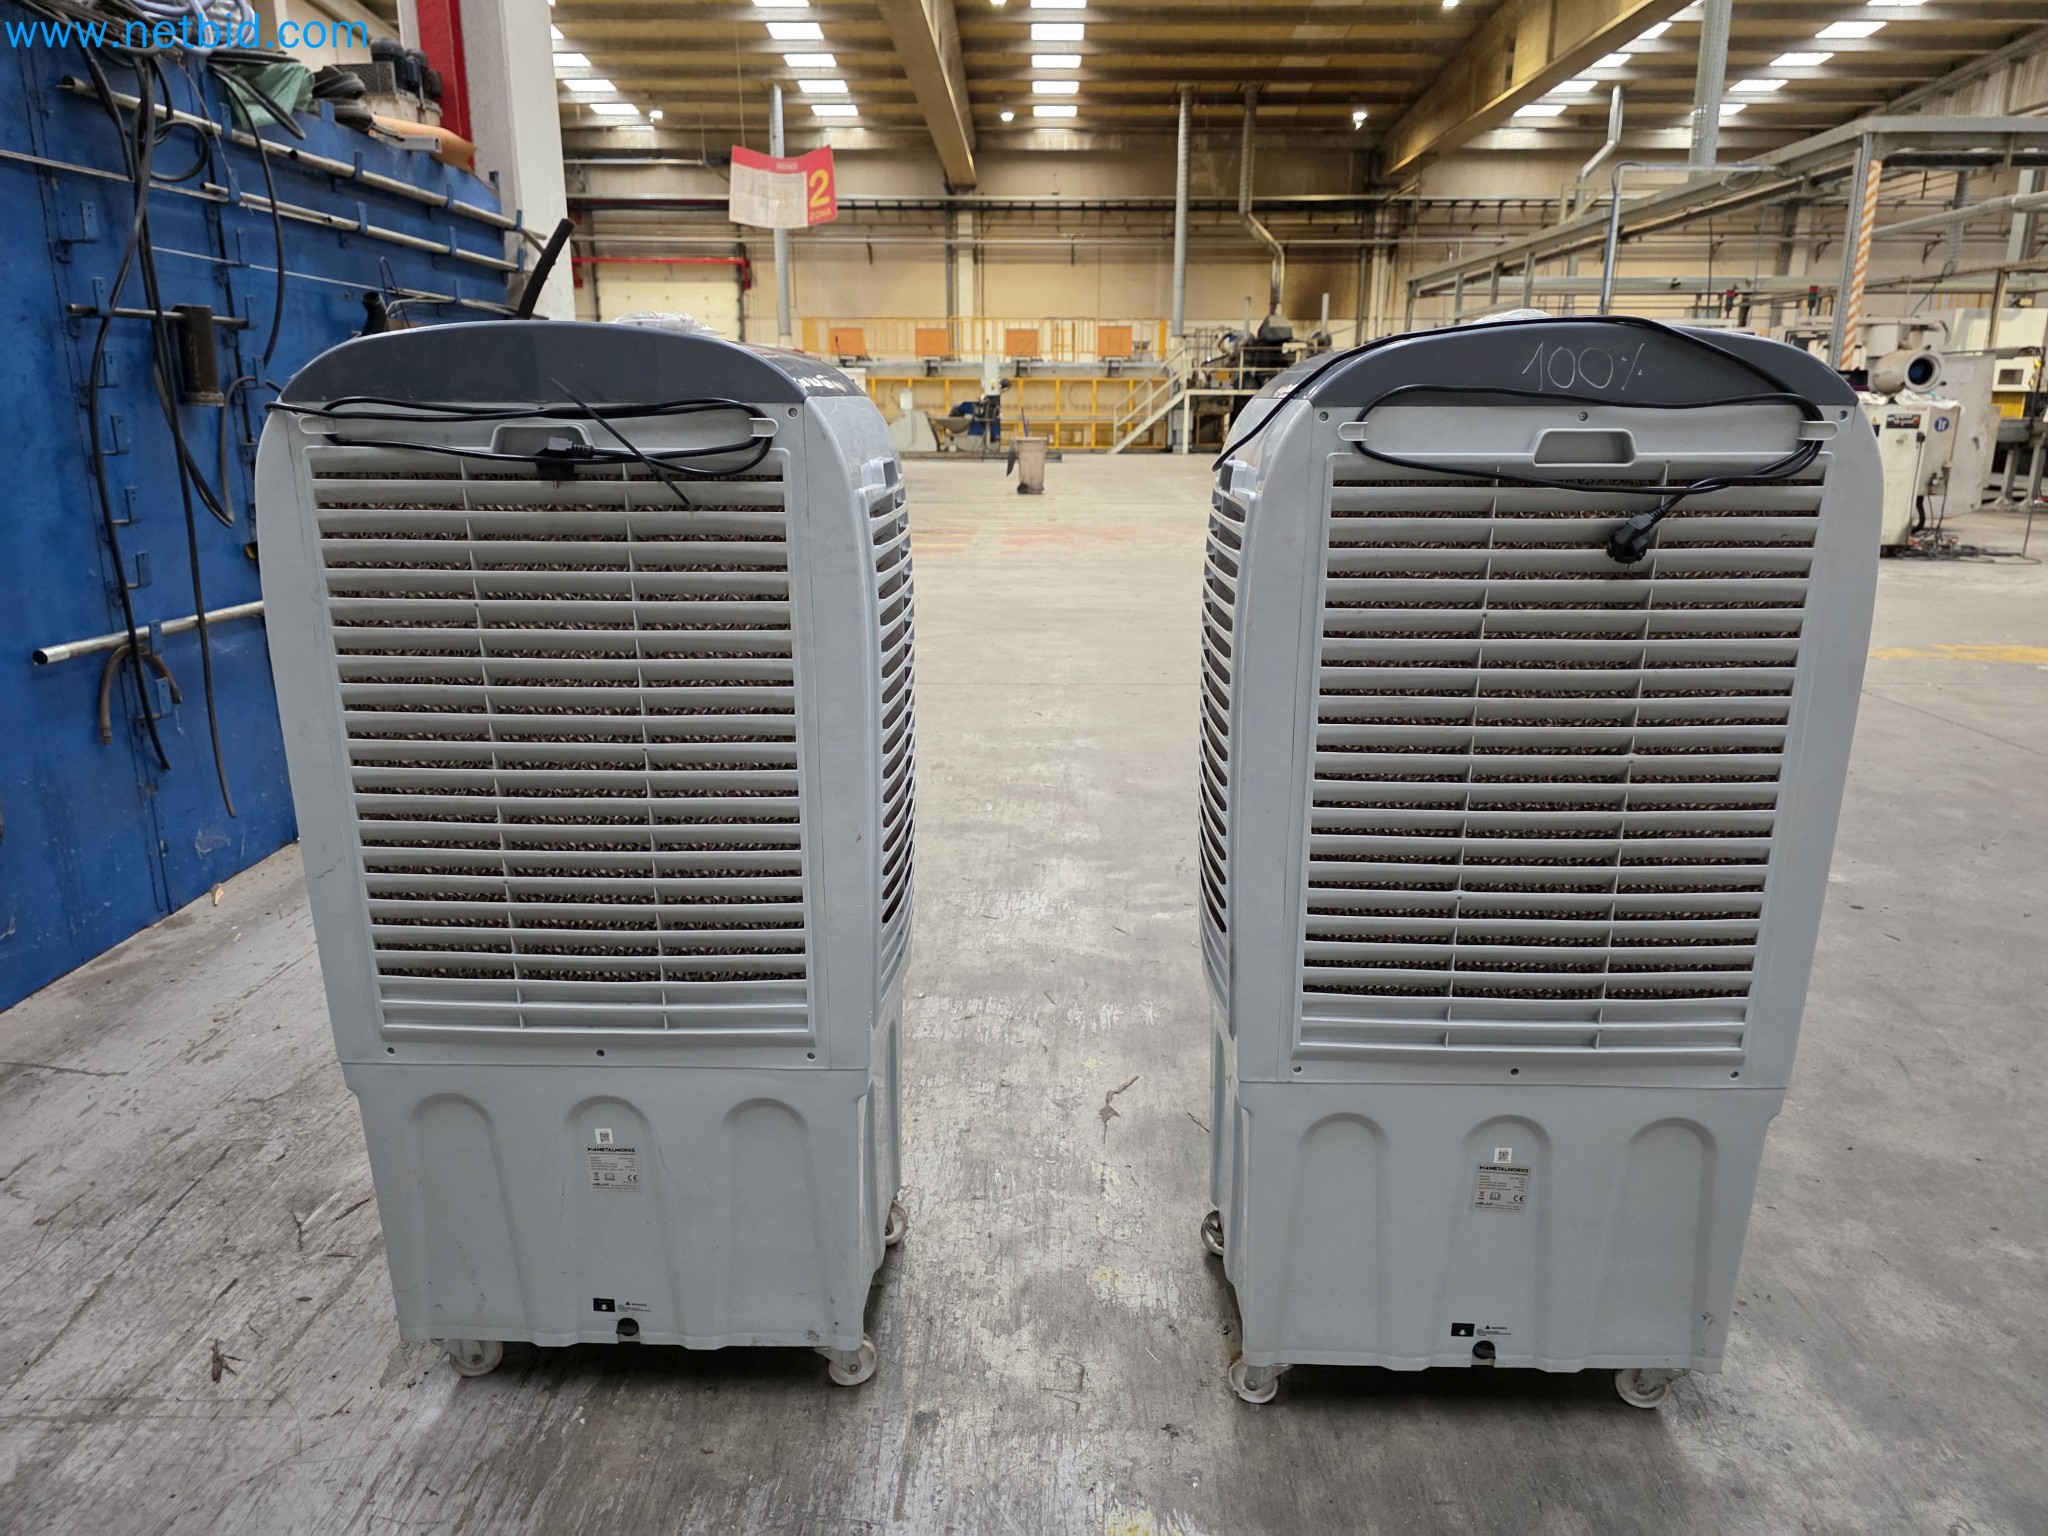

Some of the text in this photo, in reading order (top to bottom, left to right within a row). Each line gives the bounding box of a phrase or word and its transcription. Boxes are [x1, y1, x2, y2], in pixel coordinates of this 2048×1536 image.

[809, 169, 831, 208] 2
[1522, 341, 1645, 390] 100%
[1490, 1165, 1529, 1173] METALWORKS
